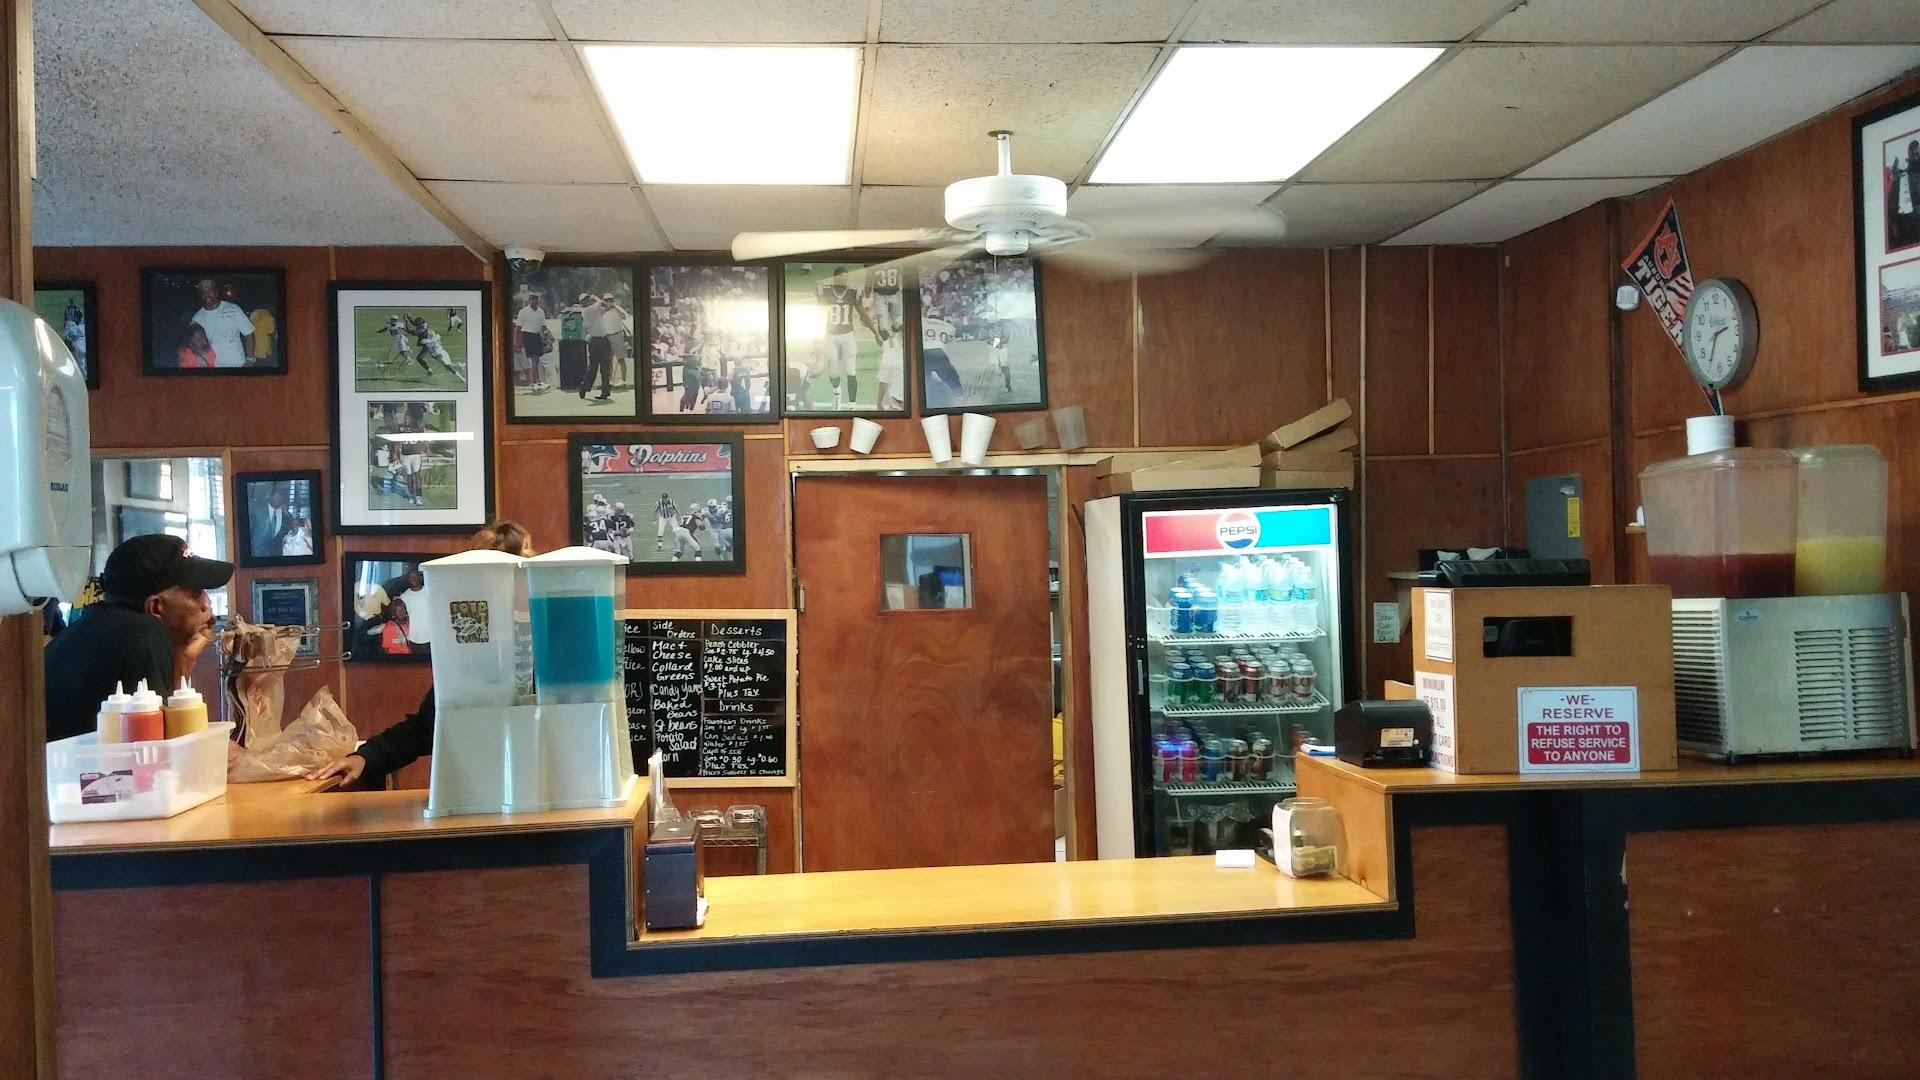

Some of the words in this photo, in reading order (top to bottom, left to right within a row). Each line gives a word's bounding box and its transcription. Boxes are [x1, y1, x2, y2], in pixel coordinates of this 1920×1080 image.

[1632, 258, 1683, 346] TIGER
[1712, 294, 1720, 304] 12
[830, 304, 850, 325] 81
[628, 444, 708, 467] Dolphins
[591, 520, 606, 533] 34
[1220, 526, 1257, 536] PEPSI
[624, 624, 640, 634] ice
[652, 621, 674, 630] Side
[711, 623, 762, 636] Desserts
[666, 630, 696, 638] Orders
[624, 644, 646, 654] ellow
[652, 641, 676, 651] Mac
[704, 639, 726, 648] Peach
[728, 640, 760, 649] Cobbler
[652, 650, 693, 660] Cheese
[652, 662, 694, 672] Collard
[740, 666, 751, 674] up
[656, 672, 696, 681] Greens
[704, 674, 727, 684] Sweet
[729, 676, 752, 684] Potato
[756, 673, 769, 682] Pie
[652, 684, 680, 701] Candy
[718, 688, 739, 698] Plus
[742, 688, 760, 697] Tax
[654, 699, 692, 711] Baked
[719, 700, 754, 712] Drinks
[627, 707, 646, 717] geon
[1542, 708, 1614, 719] RESERVE
[628, 722, 640, 730] eas
[704, 717, 736, 725] Fountain
[1536, 725, 1560, 736] THE
[1563, 725, 1601, 735] RIGHT
[1605, 725, 1621, 735] TO
[656, 732, 684, 743] Potato
[1531, 738, 1576, 748] REFUSE
[1578, 738, 1626, 748] SERVICE
[662, 753, 679, 762] orn
[1544, 751, 1560, 761] TO
[1563, 751, 1616, 761] ANYONE
